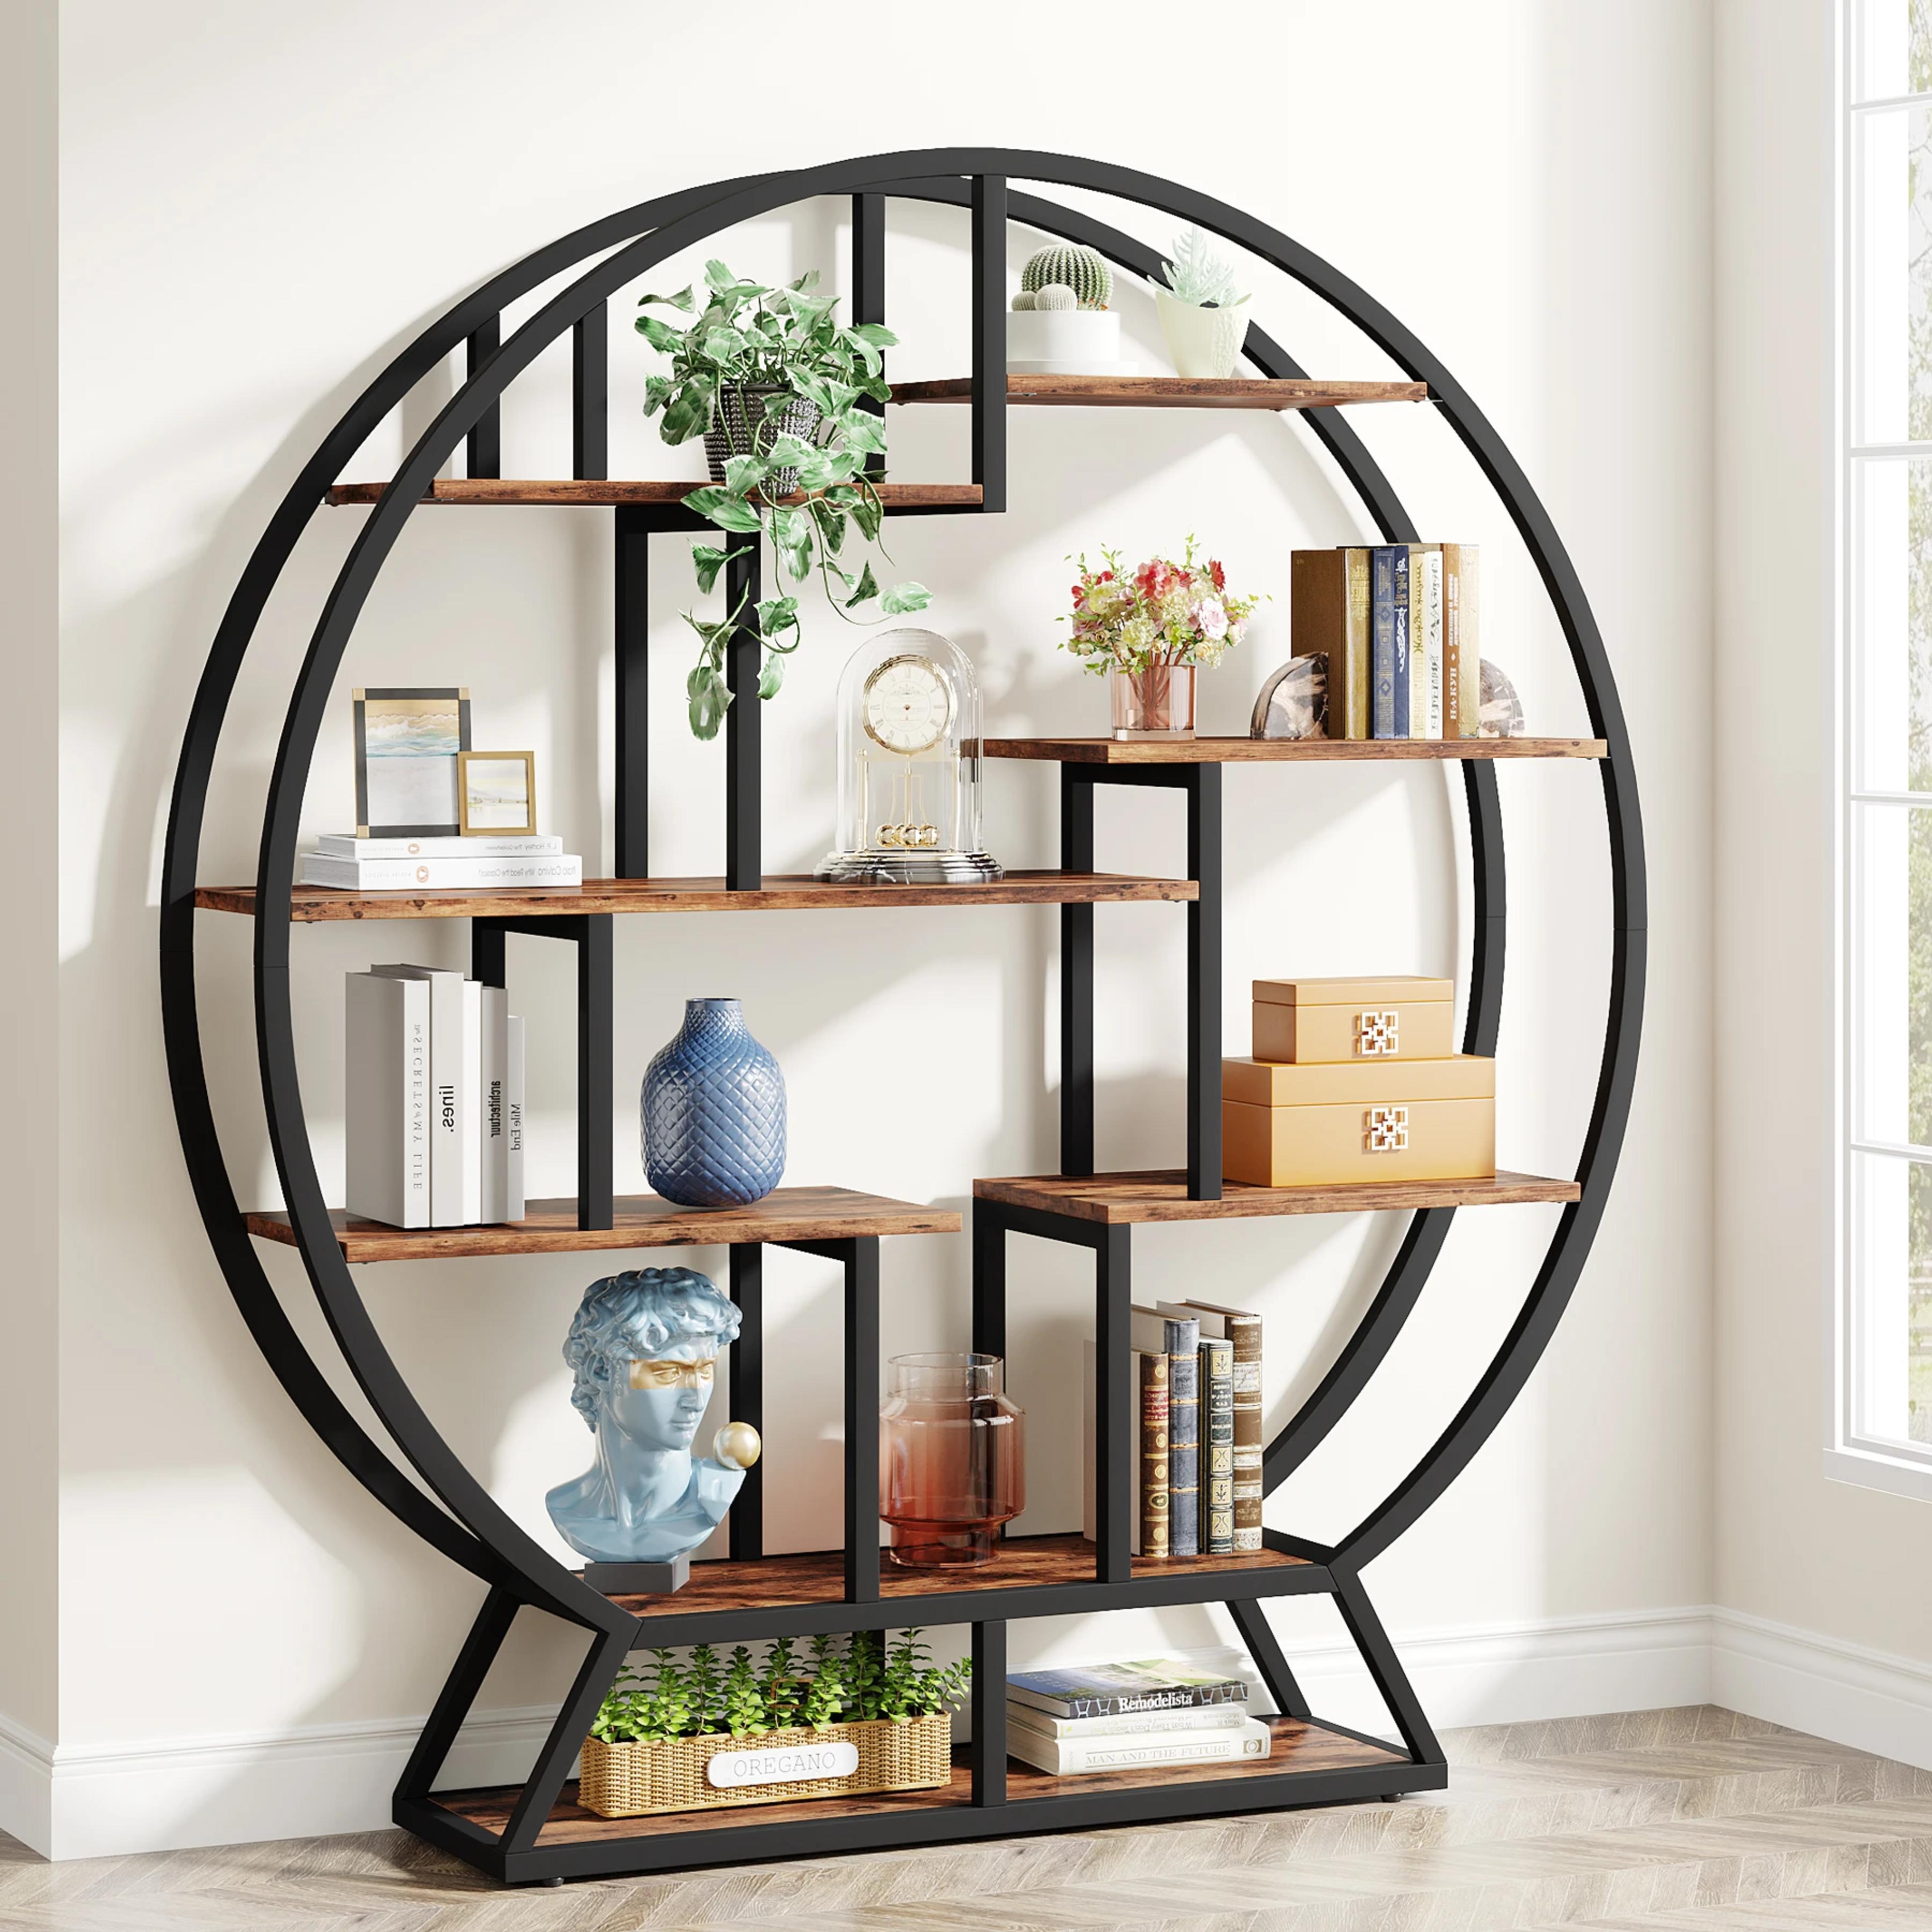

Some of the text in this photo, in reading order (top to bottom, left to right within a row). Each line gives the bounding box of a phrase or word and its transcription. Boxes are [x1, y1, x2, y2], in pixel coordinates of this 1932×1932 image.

[1413, 562, 1424, 654] Жажда жизни
[1118, 1691, 1193, 1712] Remodelista
[1151, 1721, 1170, 1732] They
[1171, 1721, 1192, 1730] What
[733, 1751, 836, 1777] OREGANO
[1085, 1744, 1231, 1765] MAN AND THE FUTURE
